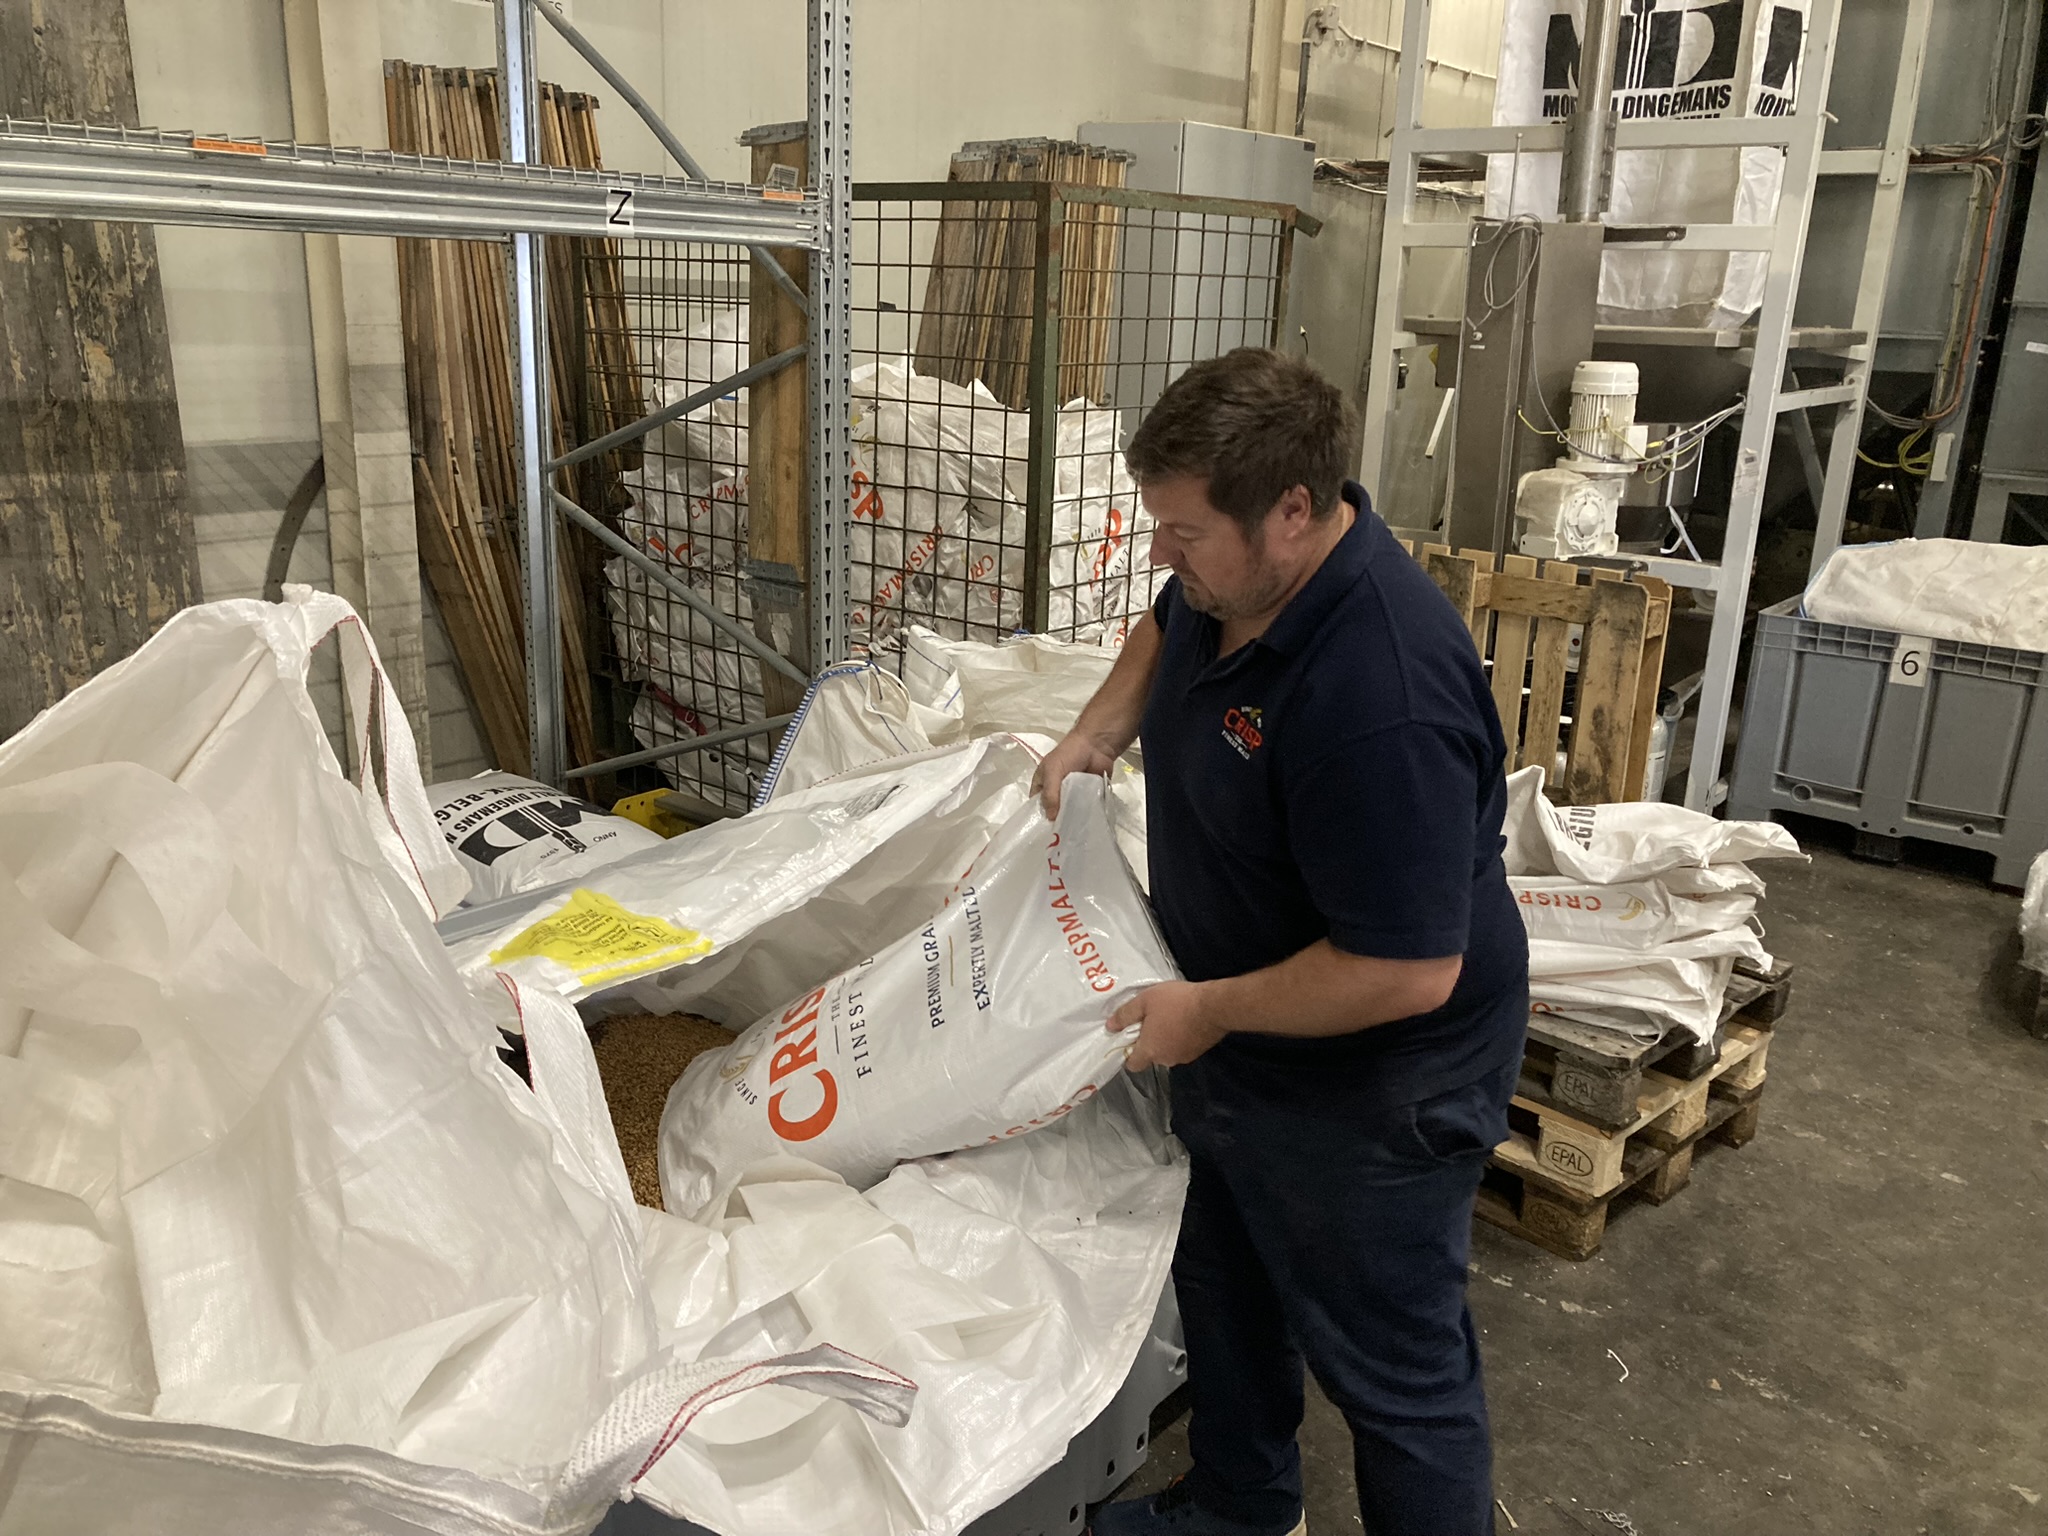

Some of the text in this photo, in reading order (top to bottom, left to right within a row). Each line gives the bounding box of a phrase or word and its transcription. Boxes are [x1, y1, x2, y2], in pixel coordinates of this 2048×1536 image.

[1621, 84, 1732, 120] DINGEMANS
[609, 190, 632, 226] Z
[1900, 650, 1920, 677] 6
[455, 792, 531, 833] DINGEMANS
[1519, 890, 1602, 912] CRISP
[926, 963, 946, 1029] PREMIUM
[848, 990, 872, 1079] FINEST
[735, 1077, 758, 1105] SINCE
[1565, 1074, 1598, 1103] EPAL
[1551, 1147, 1585, 1174] EPAL
